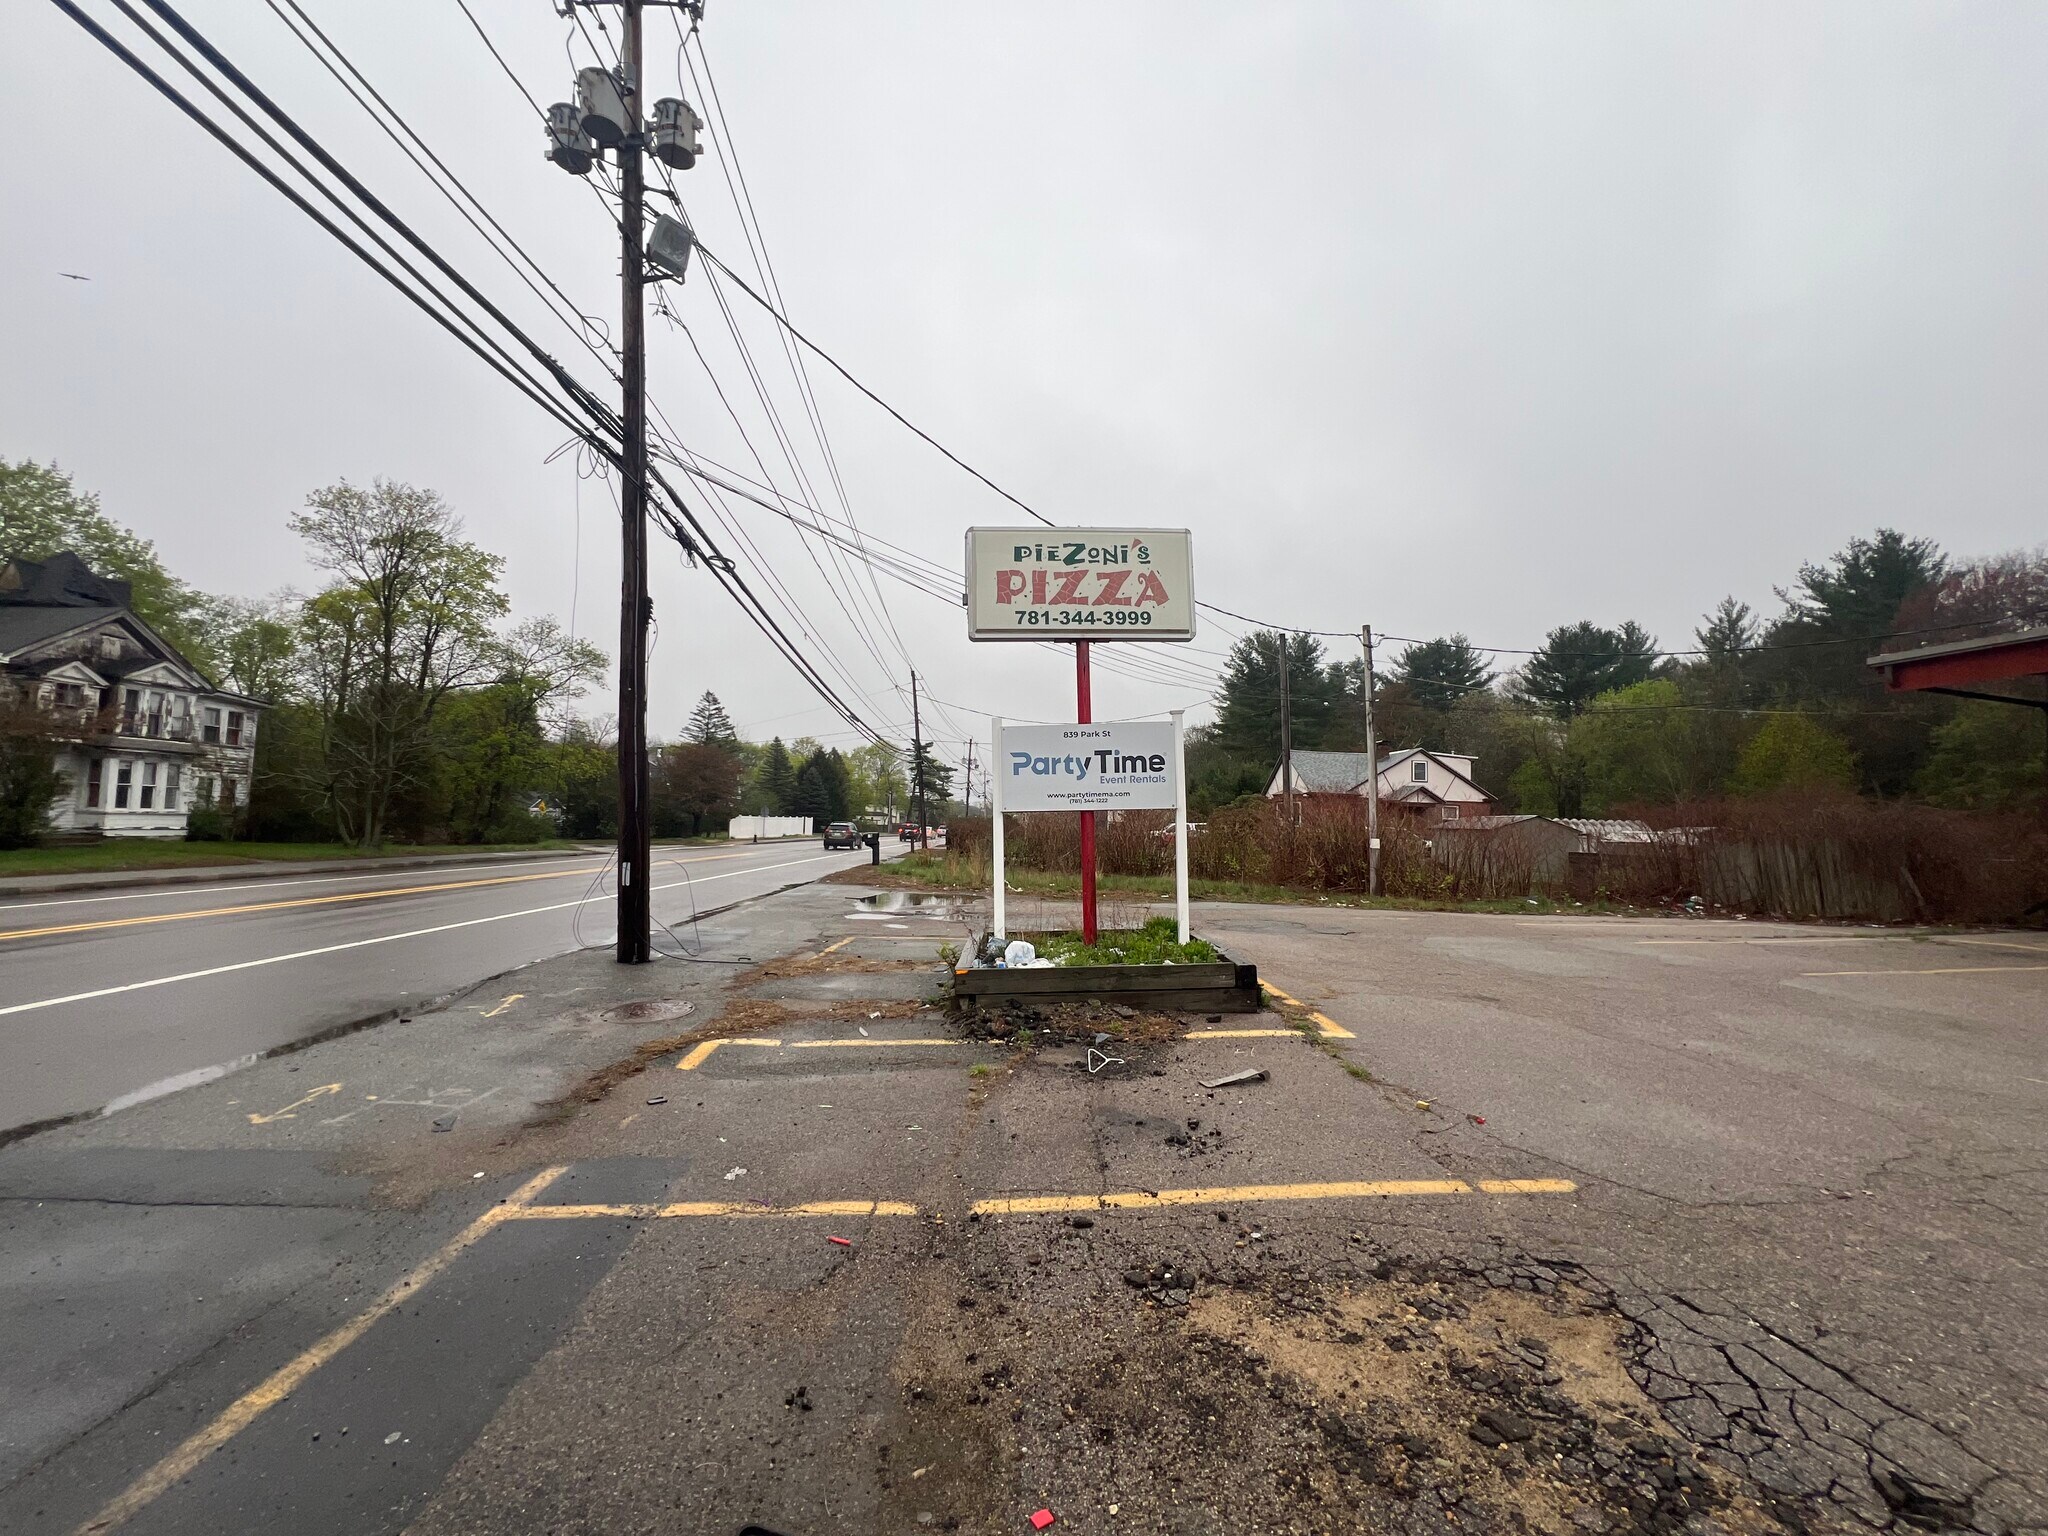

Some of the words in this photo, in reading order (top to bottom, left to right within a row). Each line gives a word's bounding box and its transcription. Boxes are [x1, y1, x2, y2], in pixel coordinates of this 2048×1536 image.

[996, 569, 1170, 607] PIZZA
[1015, 610, 1152, 625] 781-344-3999
[1063, 731, 1079, 739] 839
[1080, 730, 1100, 738] Park
[1009, 752, 1092, 781] Party
[1094, 749, 1166, 774] Time
[1100, 775, 1127, 784] Event
[1129, 774, 1167, 783] Rentals
[1046, 791, 1131, 799] www.partytimema.com
